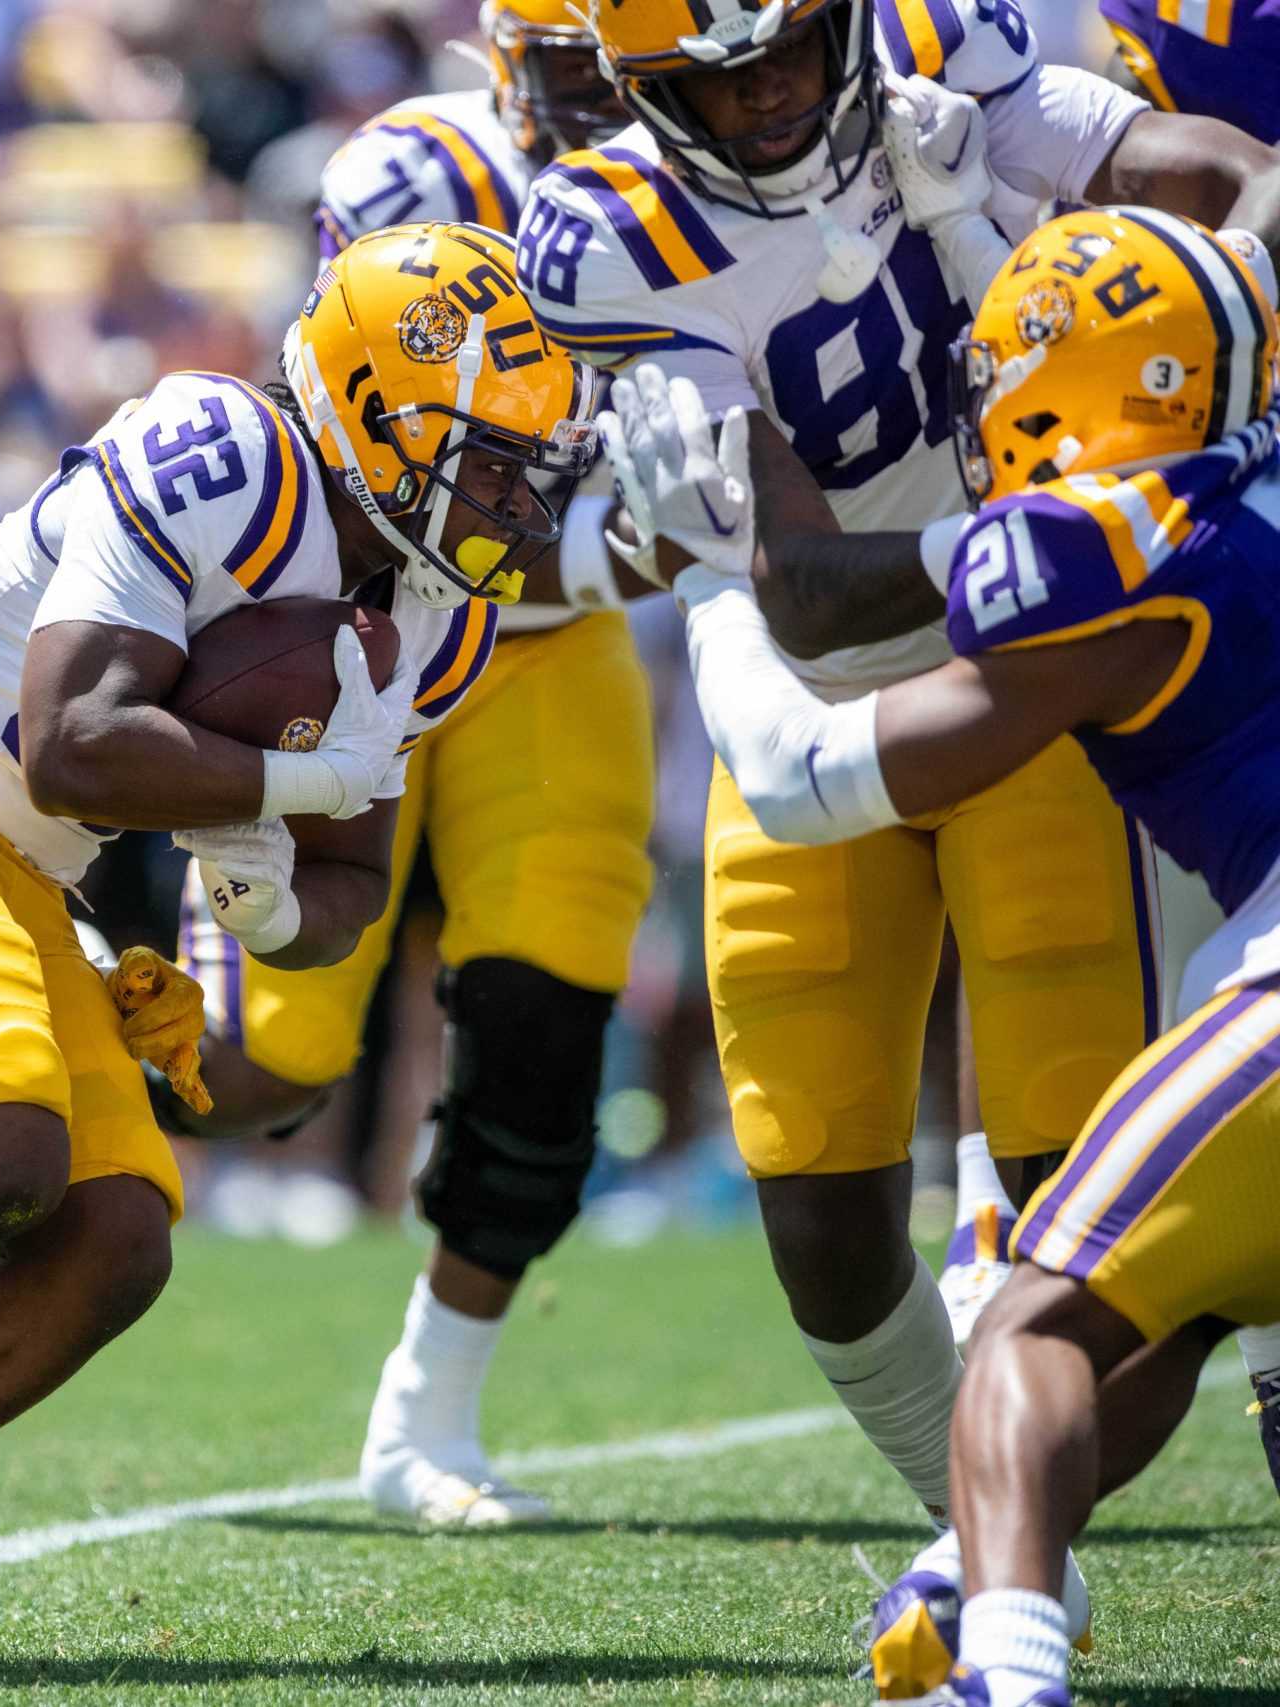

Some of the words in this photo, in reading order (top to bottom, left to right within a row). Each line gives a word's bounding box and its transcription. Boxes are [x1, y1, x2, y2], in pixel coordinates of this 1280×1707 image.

[398, 237, 544, 373] LSU
[516, 195, 593, 307] 88
[1155, 361, 1171, 390] 3
[142, 396, 248, 517] 32
[348, 466, 380, 516] schutt
[964, 505, 1050, 635] 21
